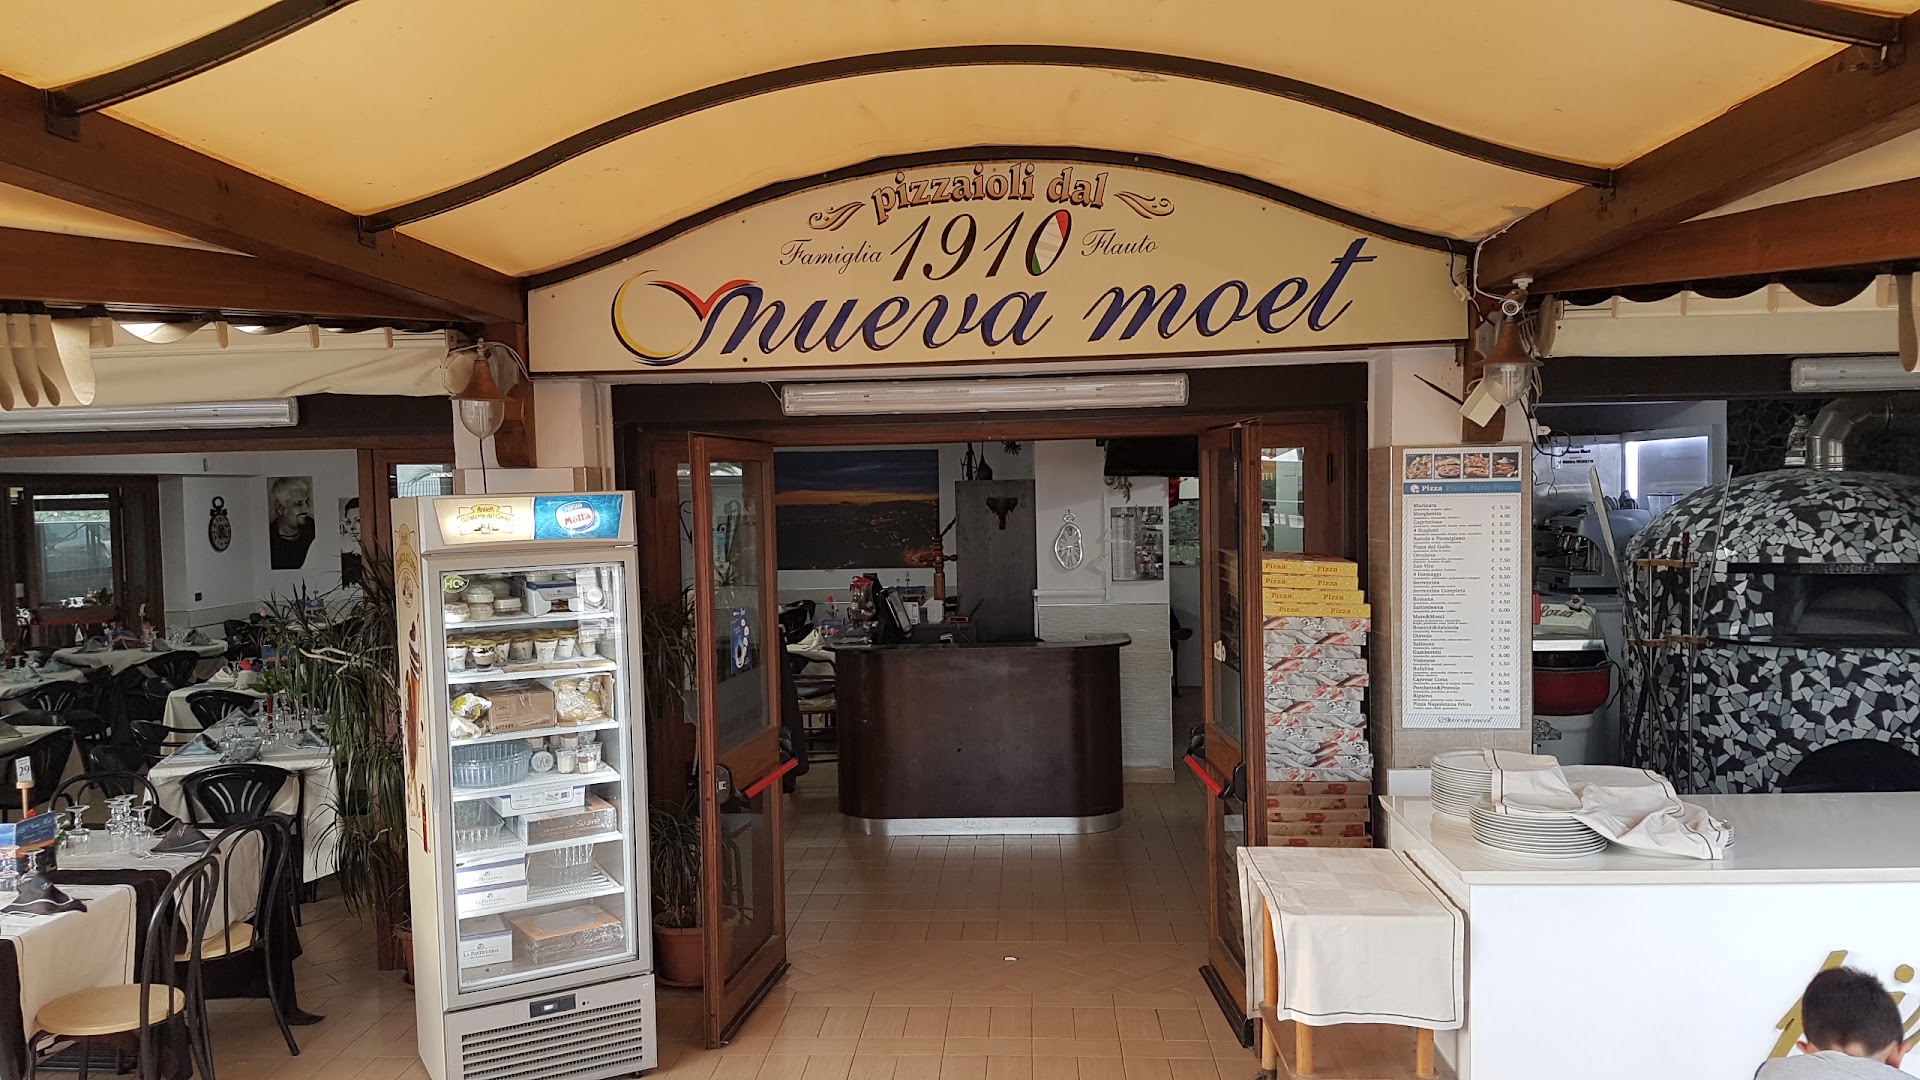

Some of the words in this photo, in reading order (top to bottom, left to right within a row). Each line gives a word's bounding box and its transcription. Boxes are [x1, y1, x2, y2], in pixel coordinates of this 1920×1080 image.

[871, 162, 1035, 225] pizzaioli
[1049, 167, 1109, 209] dal
[779, 238, 884, 275] Famiglia
[889, 208, 1073, 282] 1910
[1081, 228, 1158, 257] Flauto
[690, 284, 1053, 357] nueva
[1083, 237, 1378, 343] moet
[564, 514, 591, 526] Motta
[18, 764, 30, 776] 29
